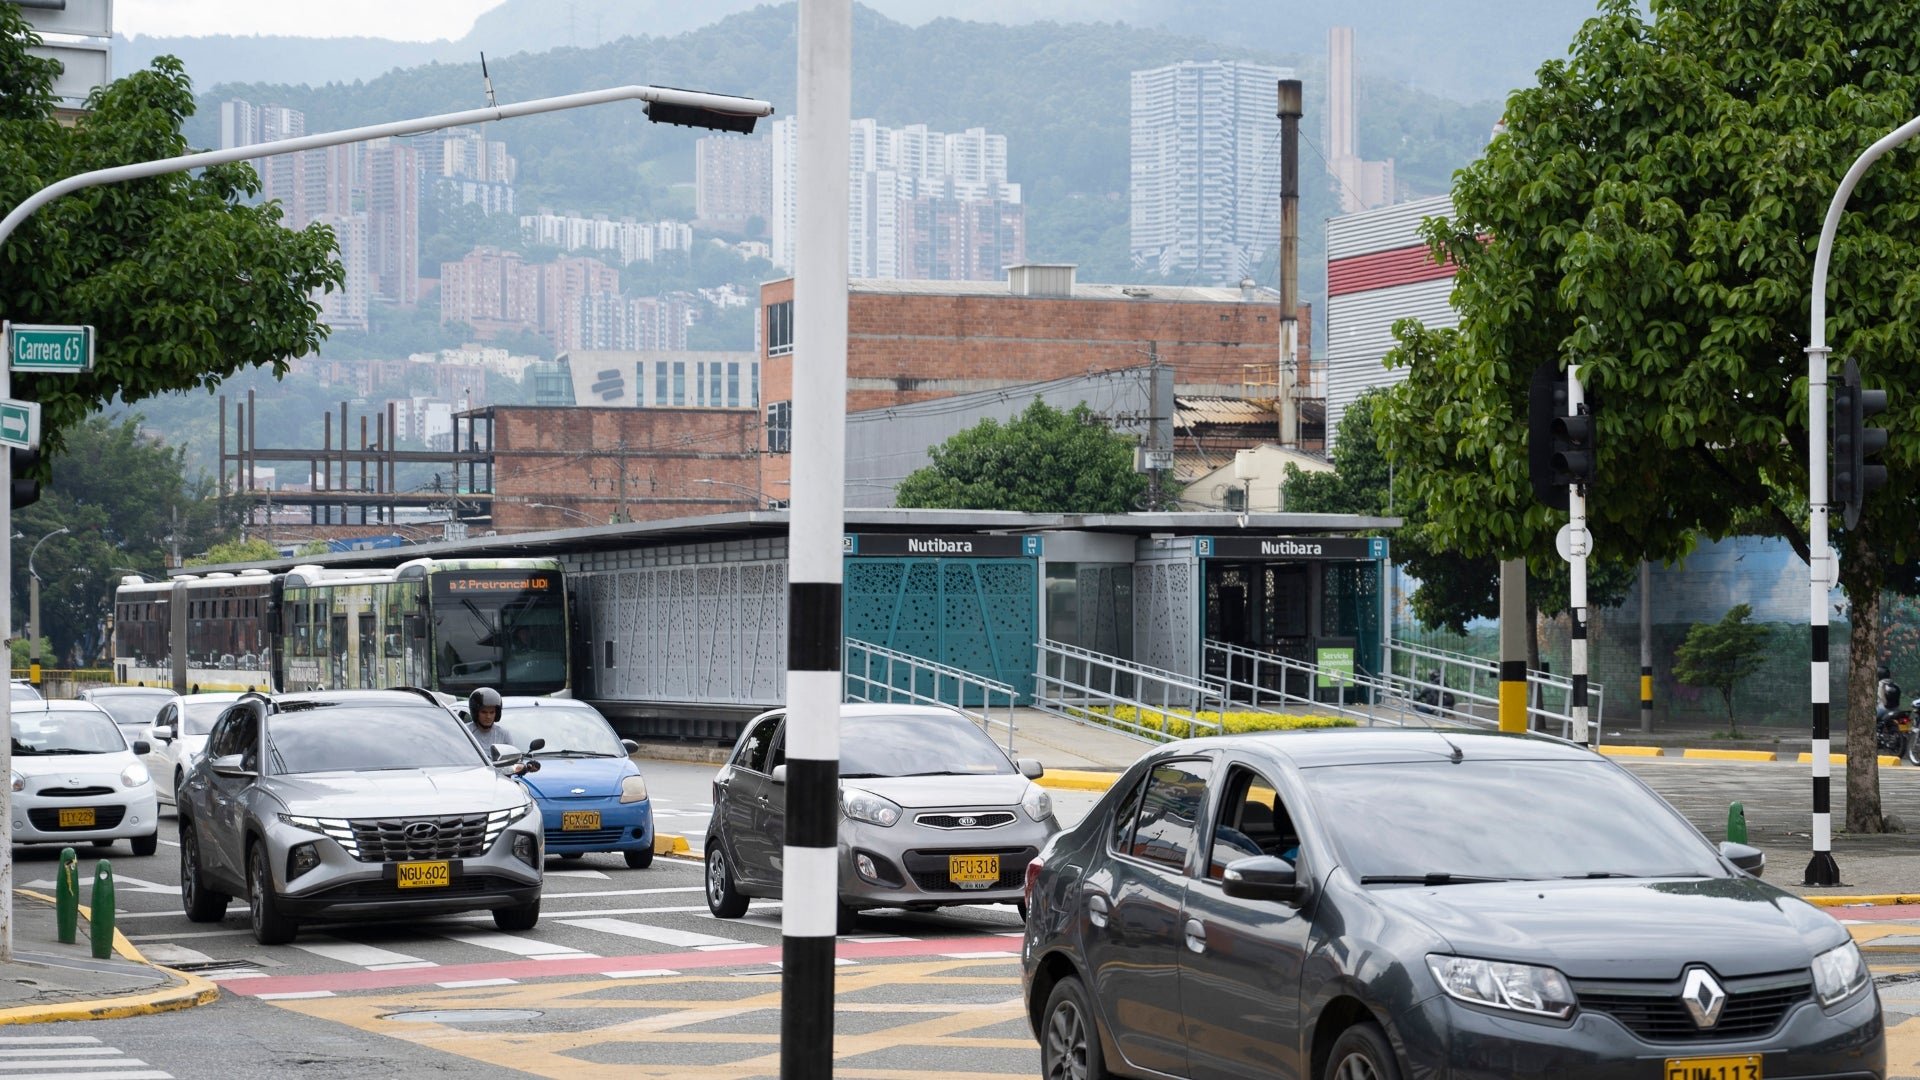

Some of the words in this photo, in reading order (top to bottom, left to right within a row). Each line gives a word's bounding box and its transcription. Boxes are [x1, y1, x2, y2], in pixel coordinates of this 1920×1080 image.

[19, 337, 61, 360] Carrera
[64, 338, 79, 361] 65
[908, 539, 973, 553] Nutibara
[1261, 541, 1322, 555] Nutibara
[459, 580, 466, 589] 2
[468, 580, 530, 589] Pretroncal
[400, 866, 447, 881] NGU-602
[952, 860, 997, 874] DFU-318
